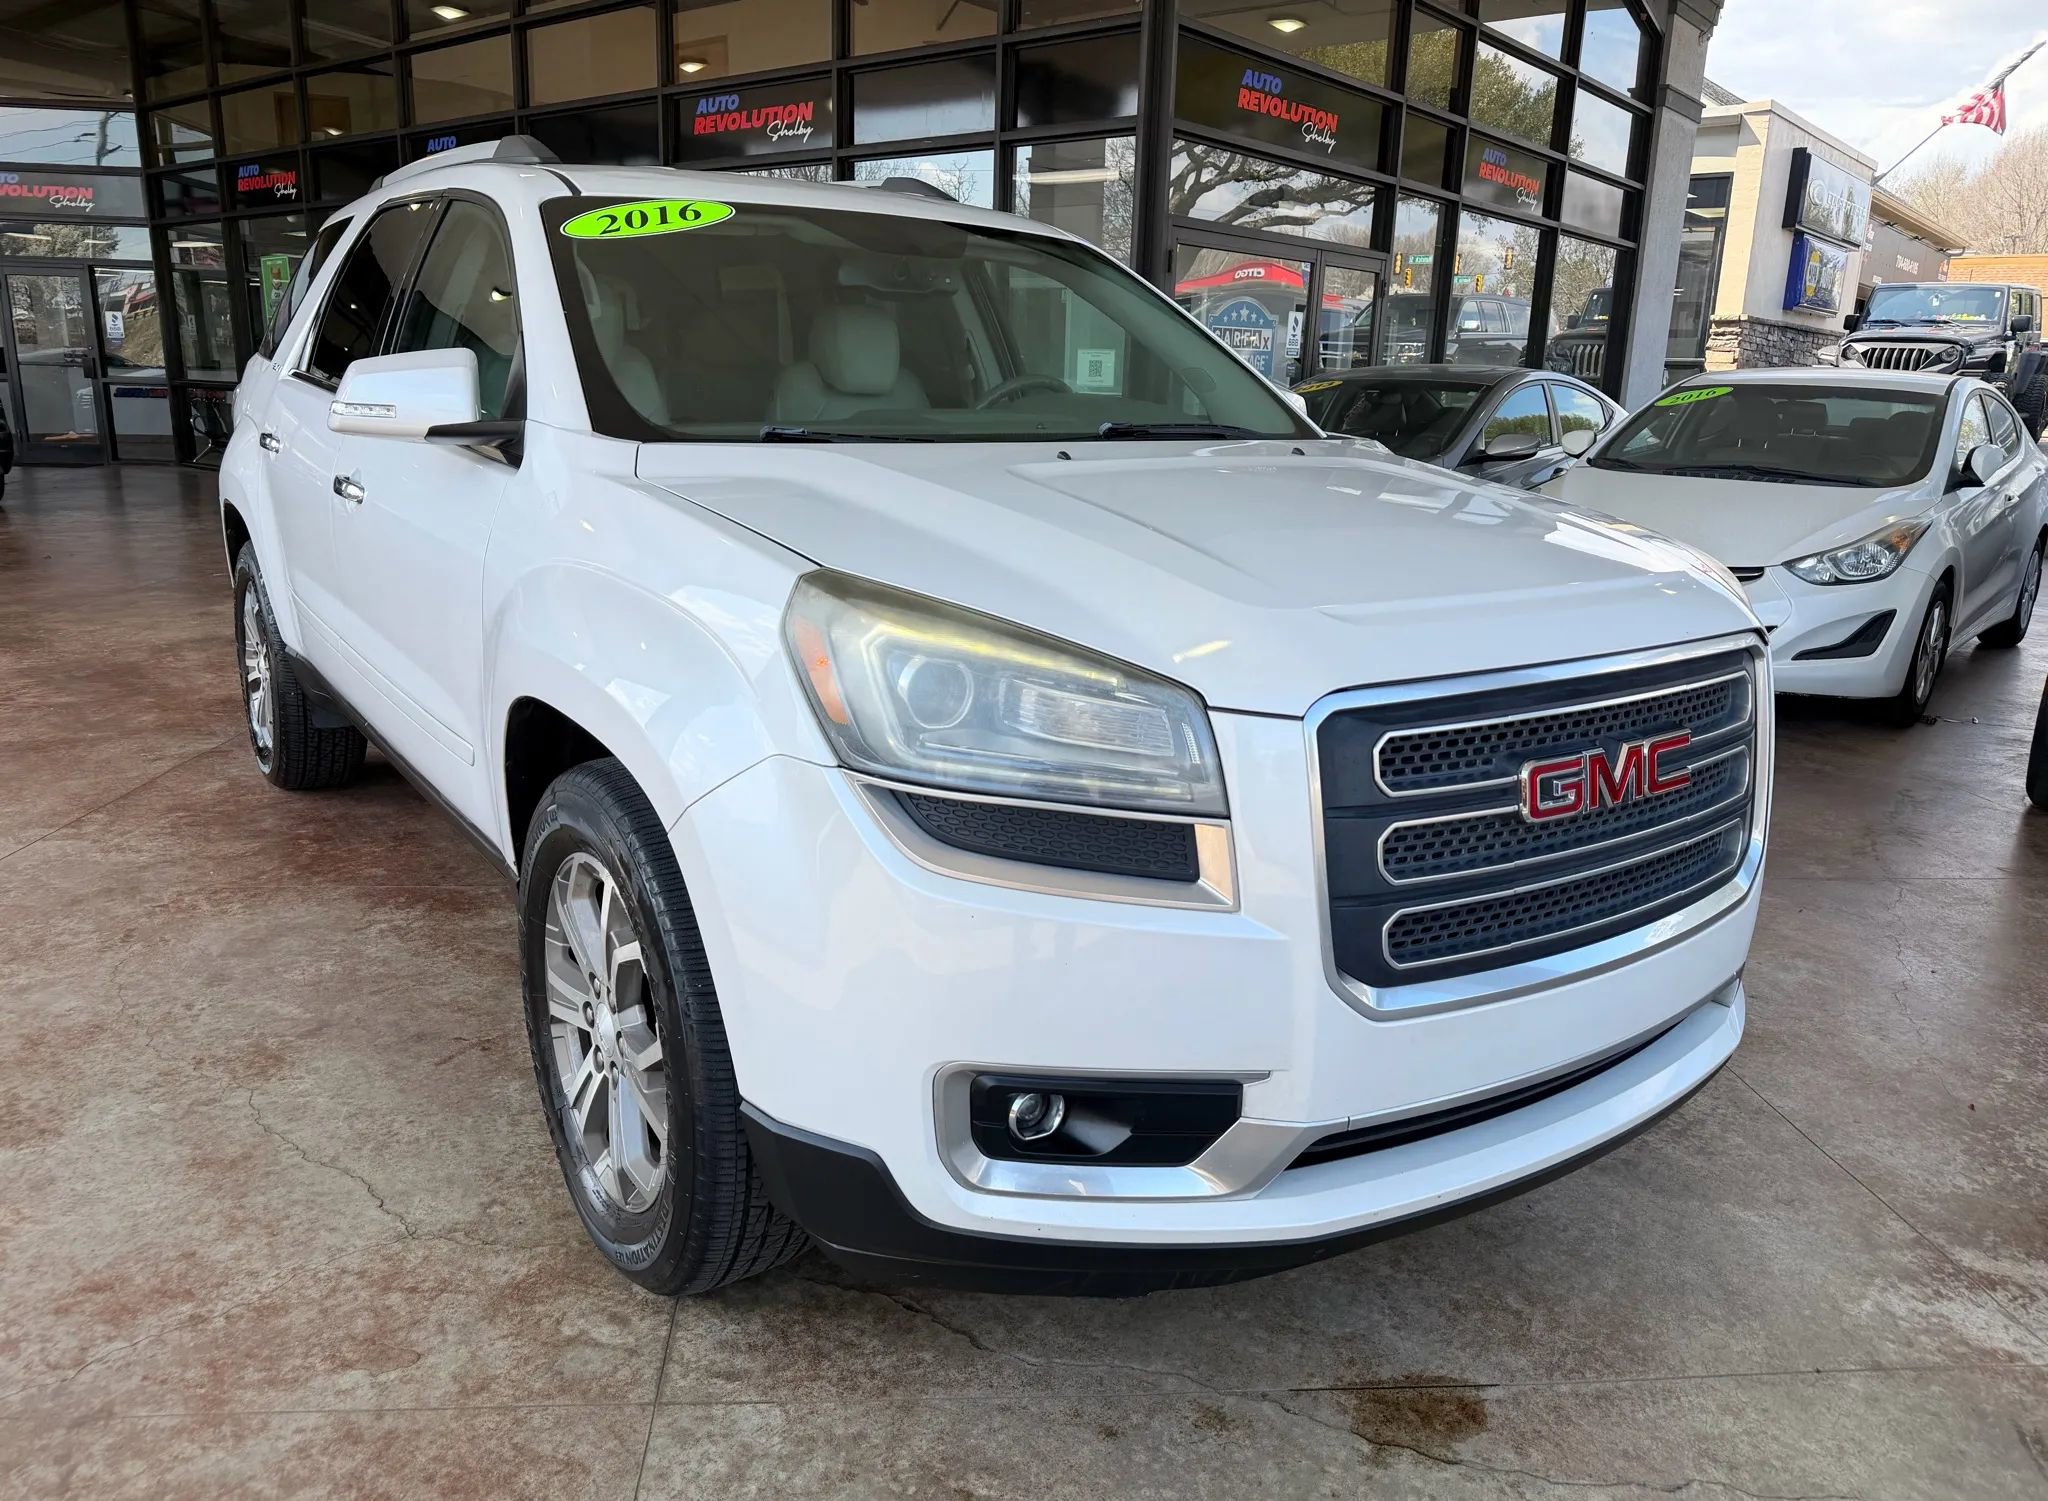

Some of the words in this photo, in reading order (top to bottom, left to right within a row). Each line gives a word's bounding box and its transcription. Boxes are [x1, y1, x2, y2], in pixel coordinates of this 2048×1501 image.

[1242, 68, 1282, 94] AUTO
[696, 94, 739, 114] AUTO
[1238, 88, 1338, 132] REVOLUTION
[694, 101, 813, 135] REVOLUTION
[767, 116, 813, 143] Shelby
[427, 135, 457, 152] AUTO
[1302, 122, 1336, 154] Shelby
[1483, 148, 1507, 166] AUTO
[238, 171, 296, 191] REVOLUTION
[239, 164, 259, 178] AUTO
[1479, 162, 1541, 195] REVOLUTION
[49, 194, 95, 212] Shelby
[274, 182, 297, 200] Shelby
[1516, 186, 1537, 211] Shelby
[597, 203, 702, 235] 2016
[1669, 391, 1716, 404] 2016
[1519, 728, 1692, 823] GMC
